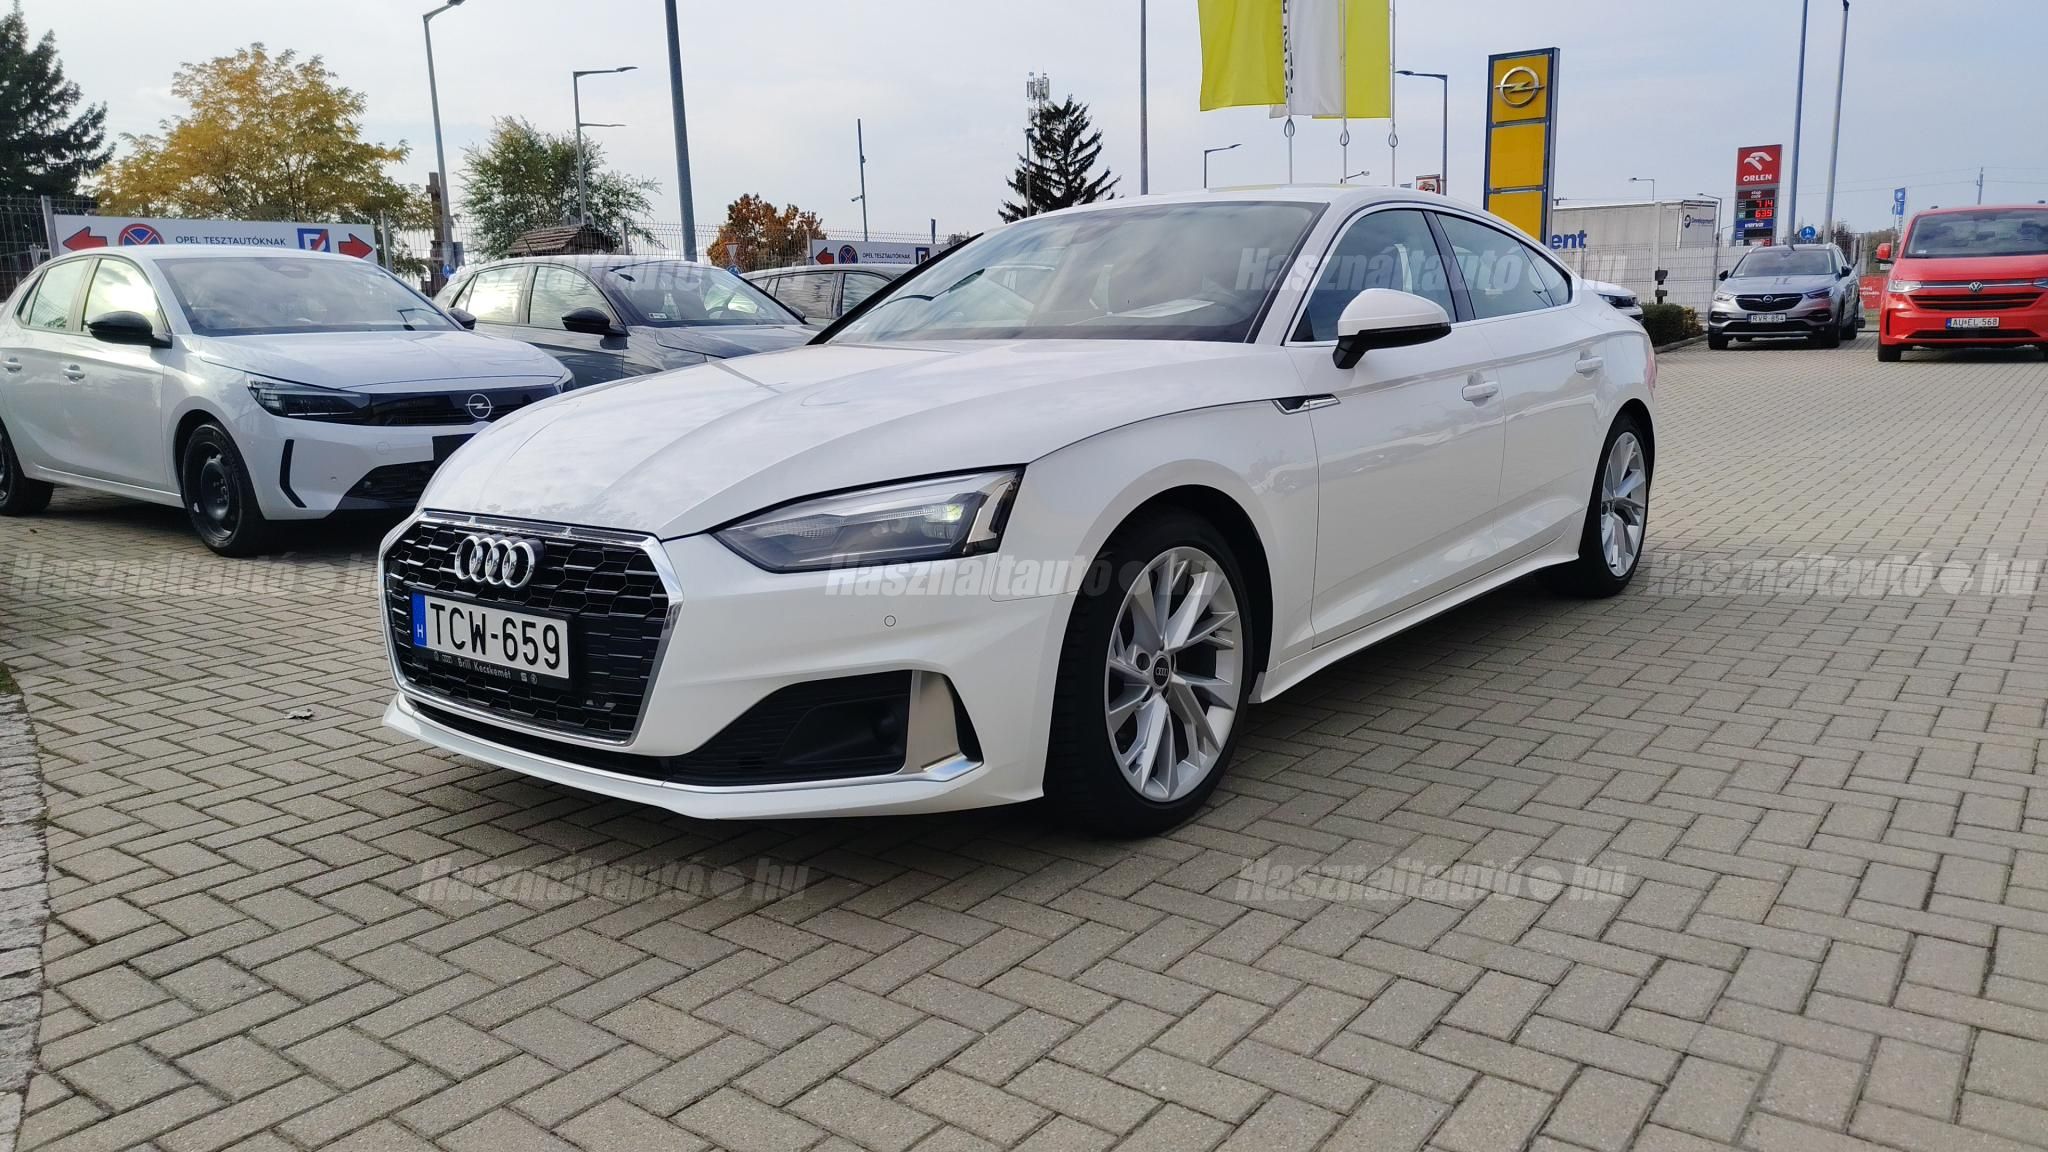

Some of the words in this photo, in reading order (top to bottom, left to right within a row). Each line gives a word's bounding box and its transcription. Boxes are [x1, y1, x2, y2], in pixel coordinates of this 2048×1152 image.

[1743, 174, 1773, 182] ORLEN
[1755, 200, 1774, 208] 714
[1755, 209, 1773, 218] 639
[175, 235, 201, 244] OPEL
[204, 235, 286, 246] TESZTAUTÓKNAK
[416, 623, 424, 639] H
[430, 603, 560, 670] TCW-659
[473, 661, 512, 679] Kecskemét
